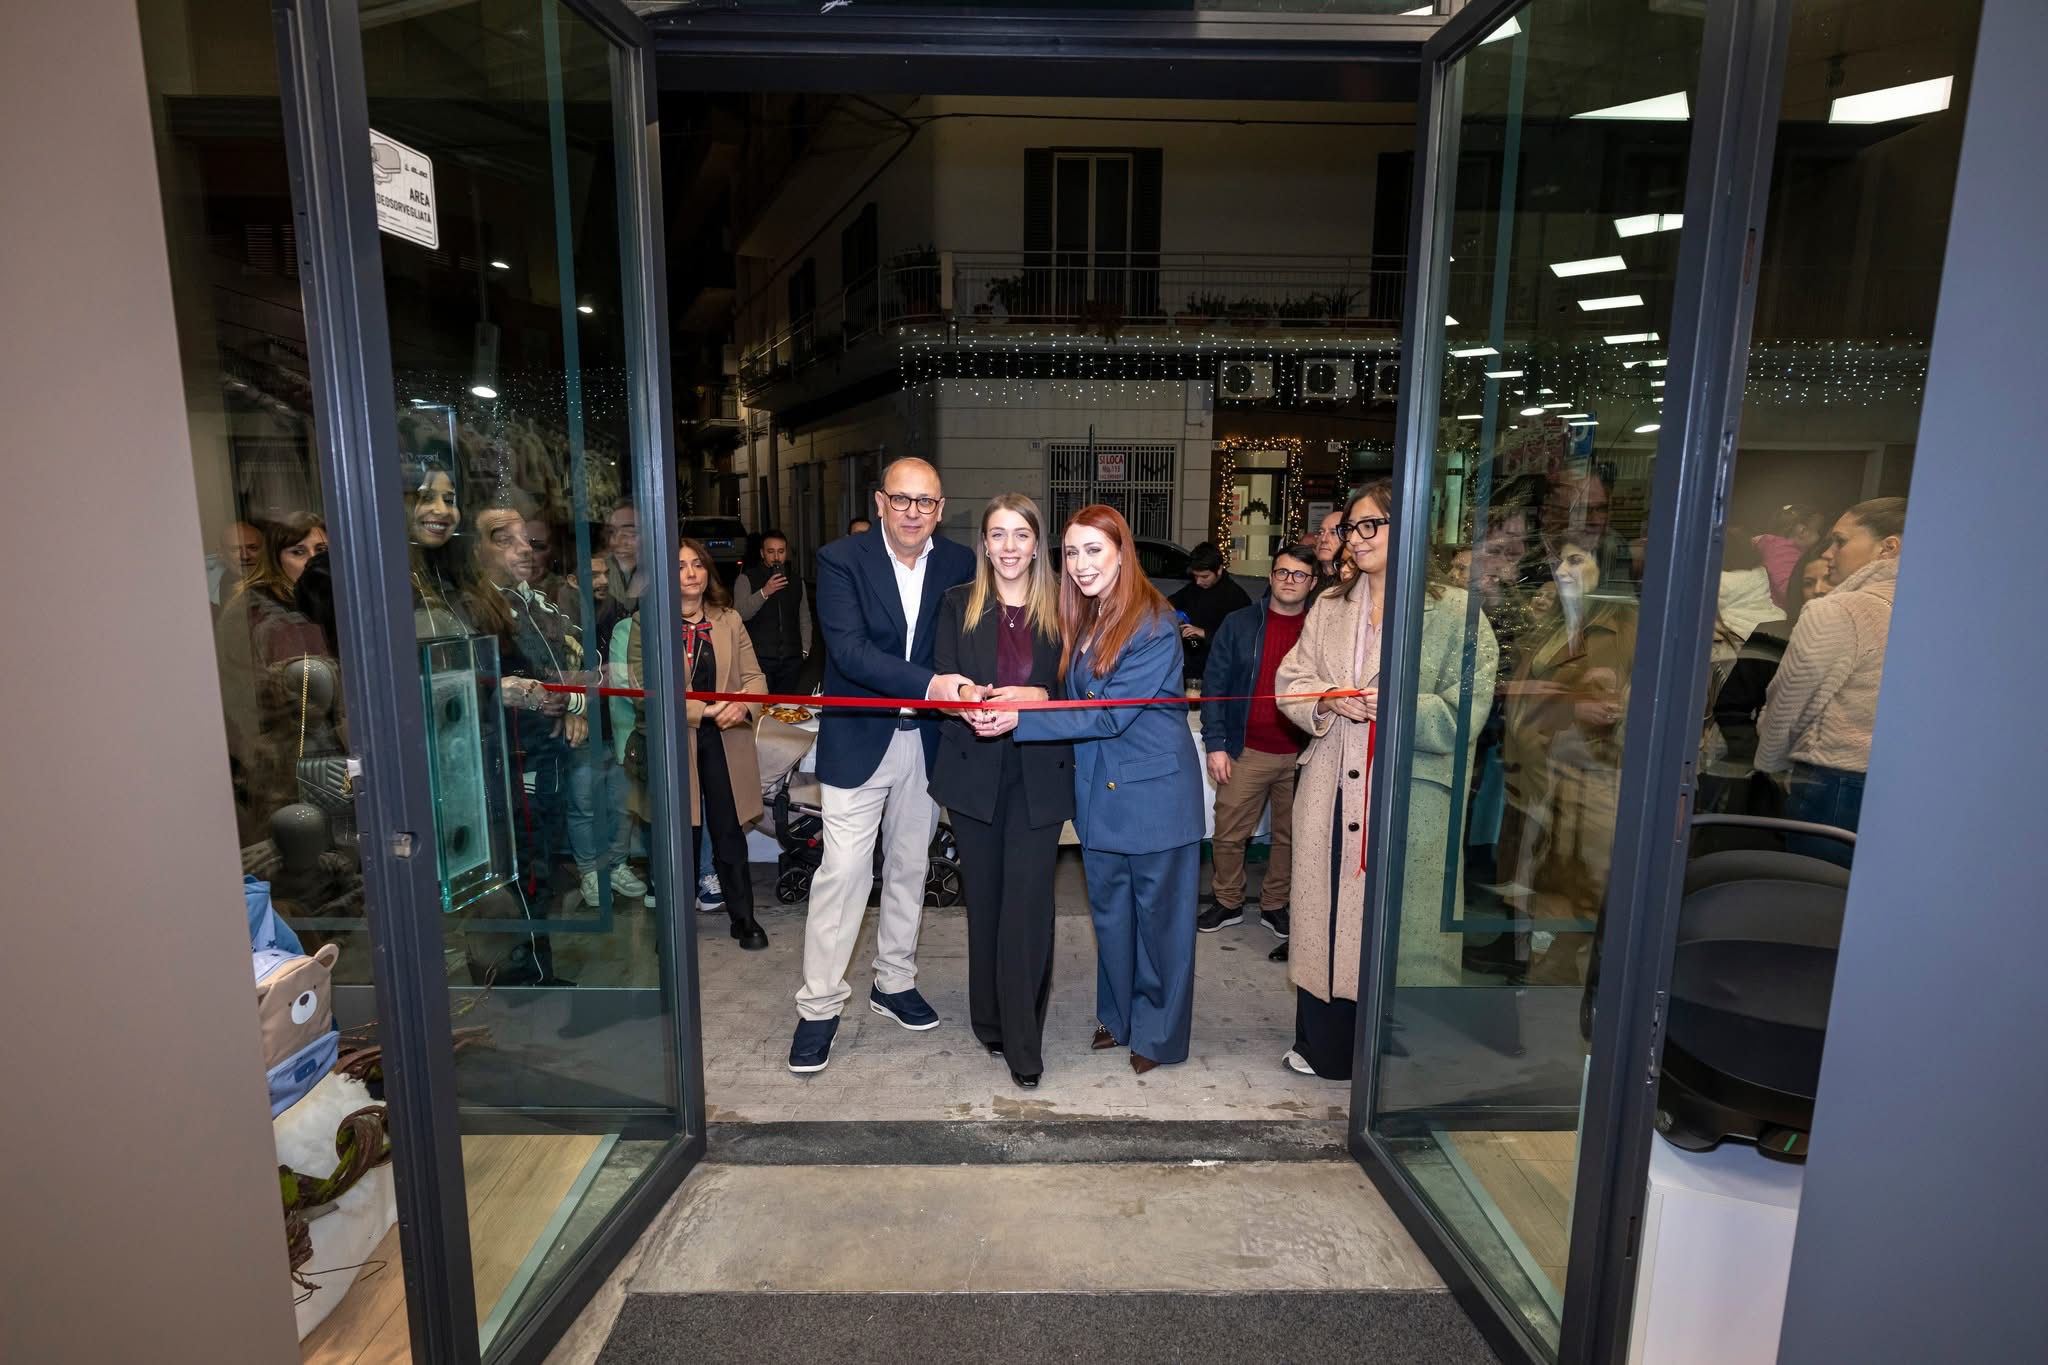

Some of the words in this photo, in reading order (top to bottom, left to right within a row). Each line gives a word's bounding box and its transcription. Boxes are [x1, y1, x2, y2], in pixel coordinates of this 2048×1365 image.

[409, 187, 431, 208] AREA
[376, 193, 432, 224] DEOSORVEGLIATA
[1099, 455, 1105, 464] SI
[1106, 455, 1124, 464] LOCA
